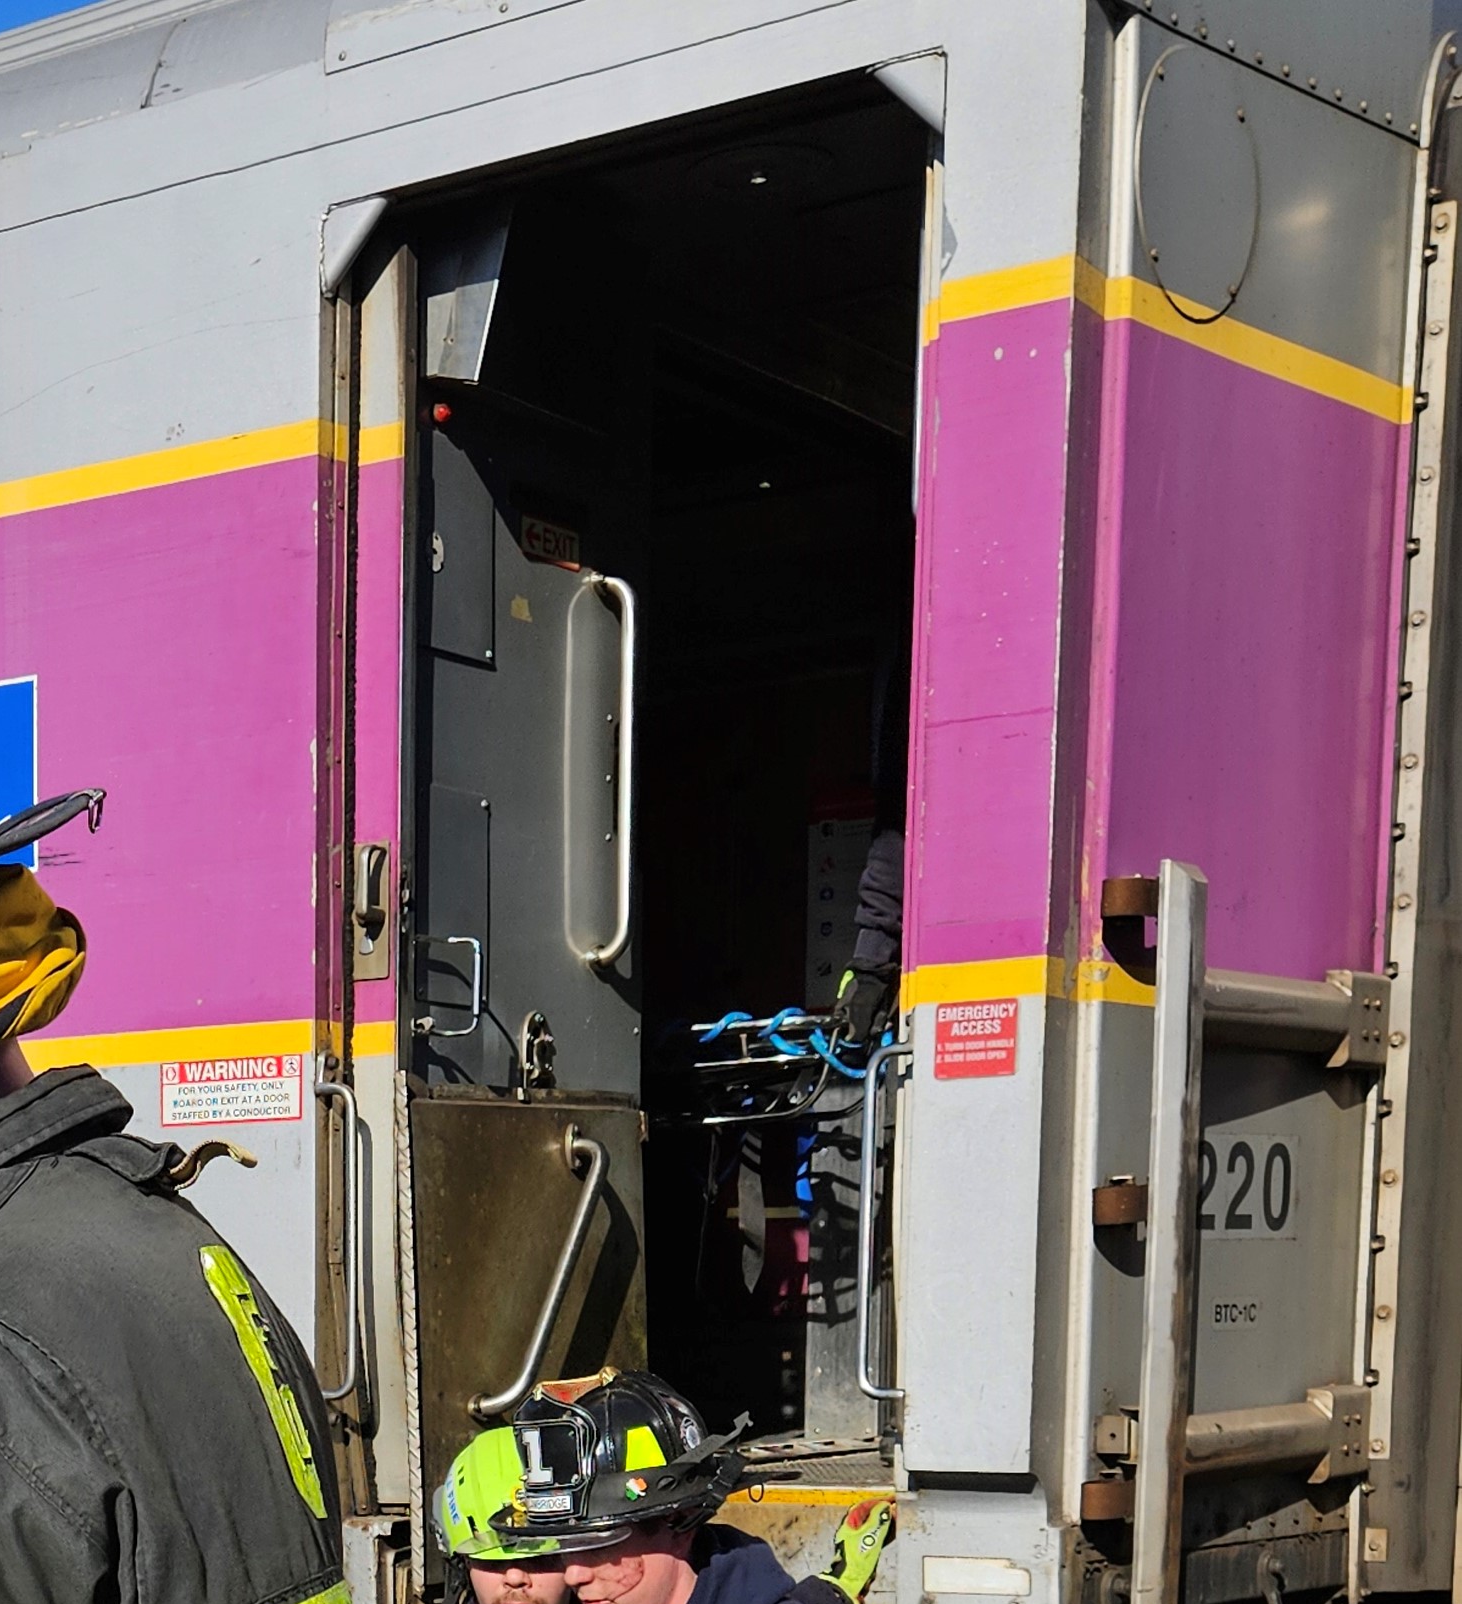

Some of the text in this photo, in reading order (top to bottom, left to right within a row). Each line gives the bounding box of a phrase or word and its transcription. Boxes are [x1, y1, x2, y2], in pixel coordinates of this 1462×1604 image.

[543, 527, 576, 560] EXIT
[938, 1003, 1017, 1022] EMERGENCY
[951, 1019, 1002, 1037] ACCESS
[184, 1058, 278, 1082] WARNING
[178, 1086, 195, 1095] FOR
[197, 1084, 222, 1094] YOUR
[261, 1081, 285, 1090] ONLY
[173, 1093, 290, 1108] BOARD OR EXIT AT A DOOR
[172, 1111, 210, 1120] STAFFED
[212, 1110, 223, 1118] BY
[233, 1107, 291, 1118] CONDUCTOR
[1215, 1304, 1257, 1323] BTC-1C
[521, 1428, 553, 1485] 1
